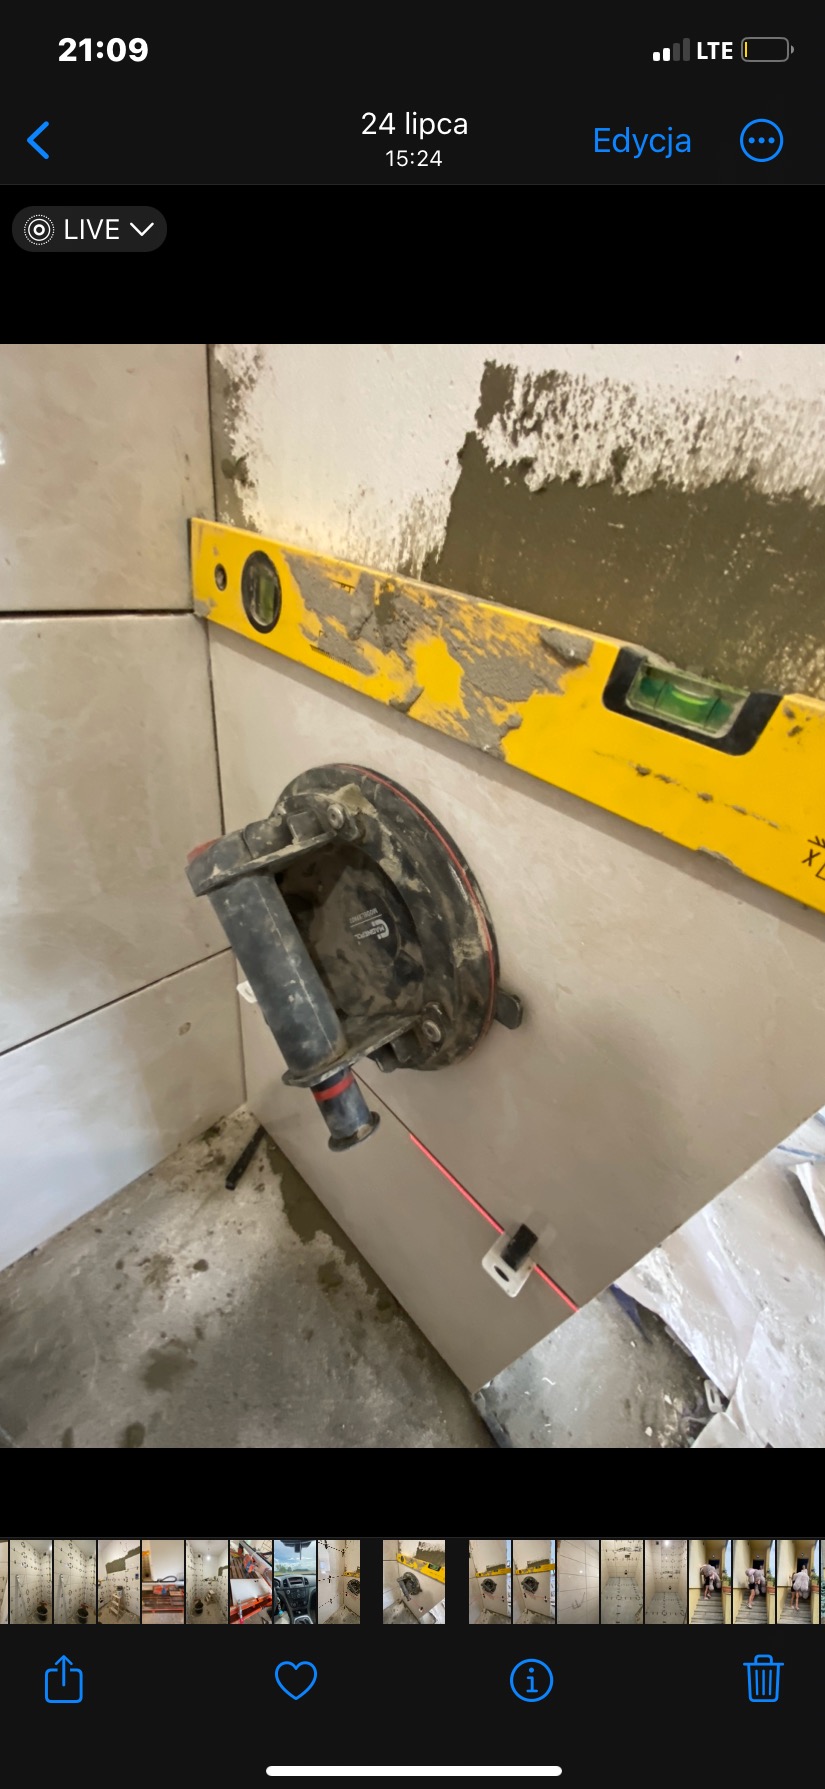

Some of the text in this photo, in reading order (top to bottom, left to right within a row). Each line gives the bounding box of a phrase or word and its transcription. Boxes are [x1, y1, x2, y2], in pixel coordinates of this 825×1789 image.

[58, 37, 149, 63] 21:09
[697, 41, 734, 60] LTE
[361, 111, 468, 140] 24 lipca
[594, 126, 691, 159] Edycja
[385, 150, 443, 168] 15:24
[64, 218, 120, 240] LIVE
